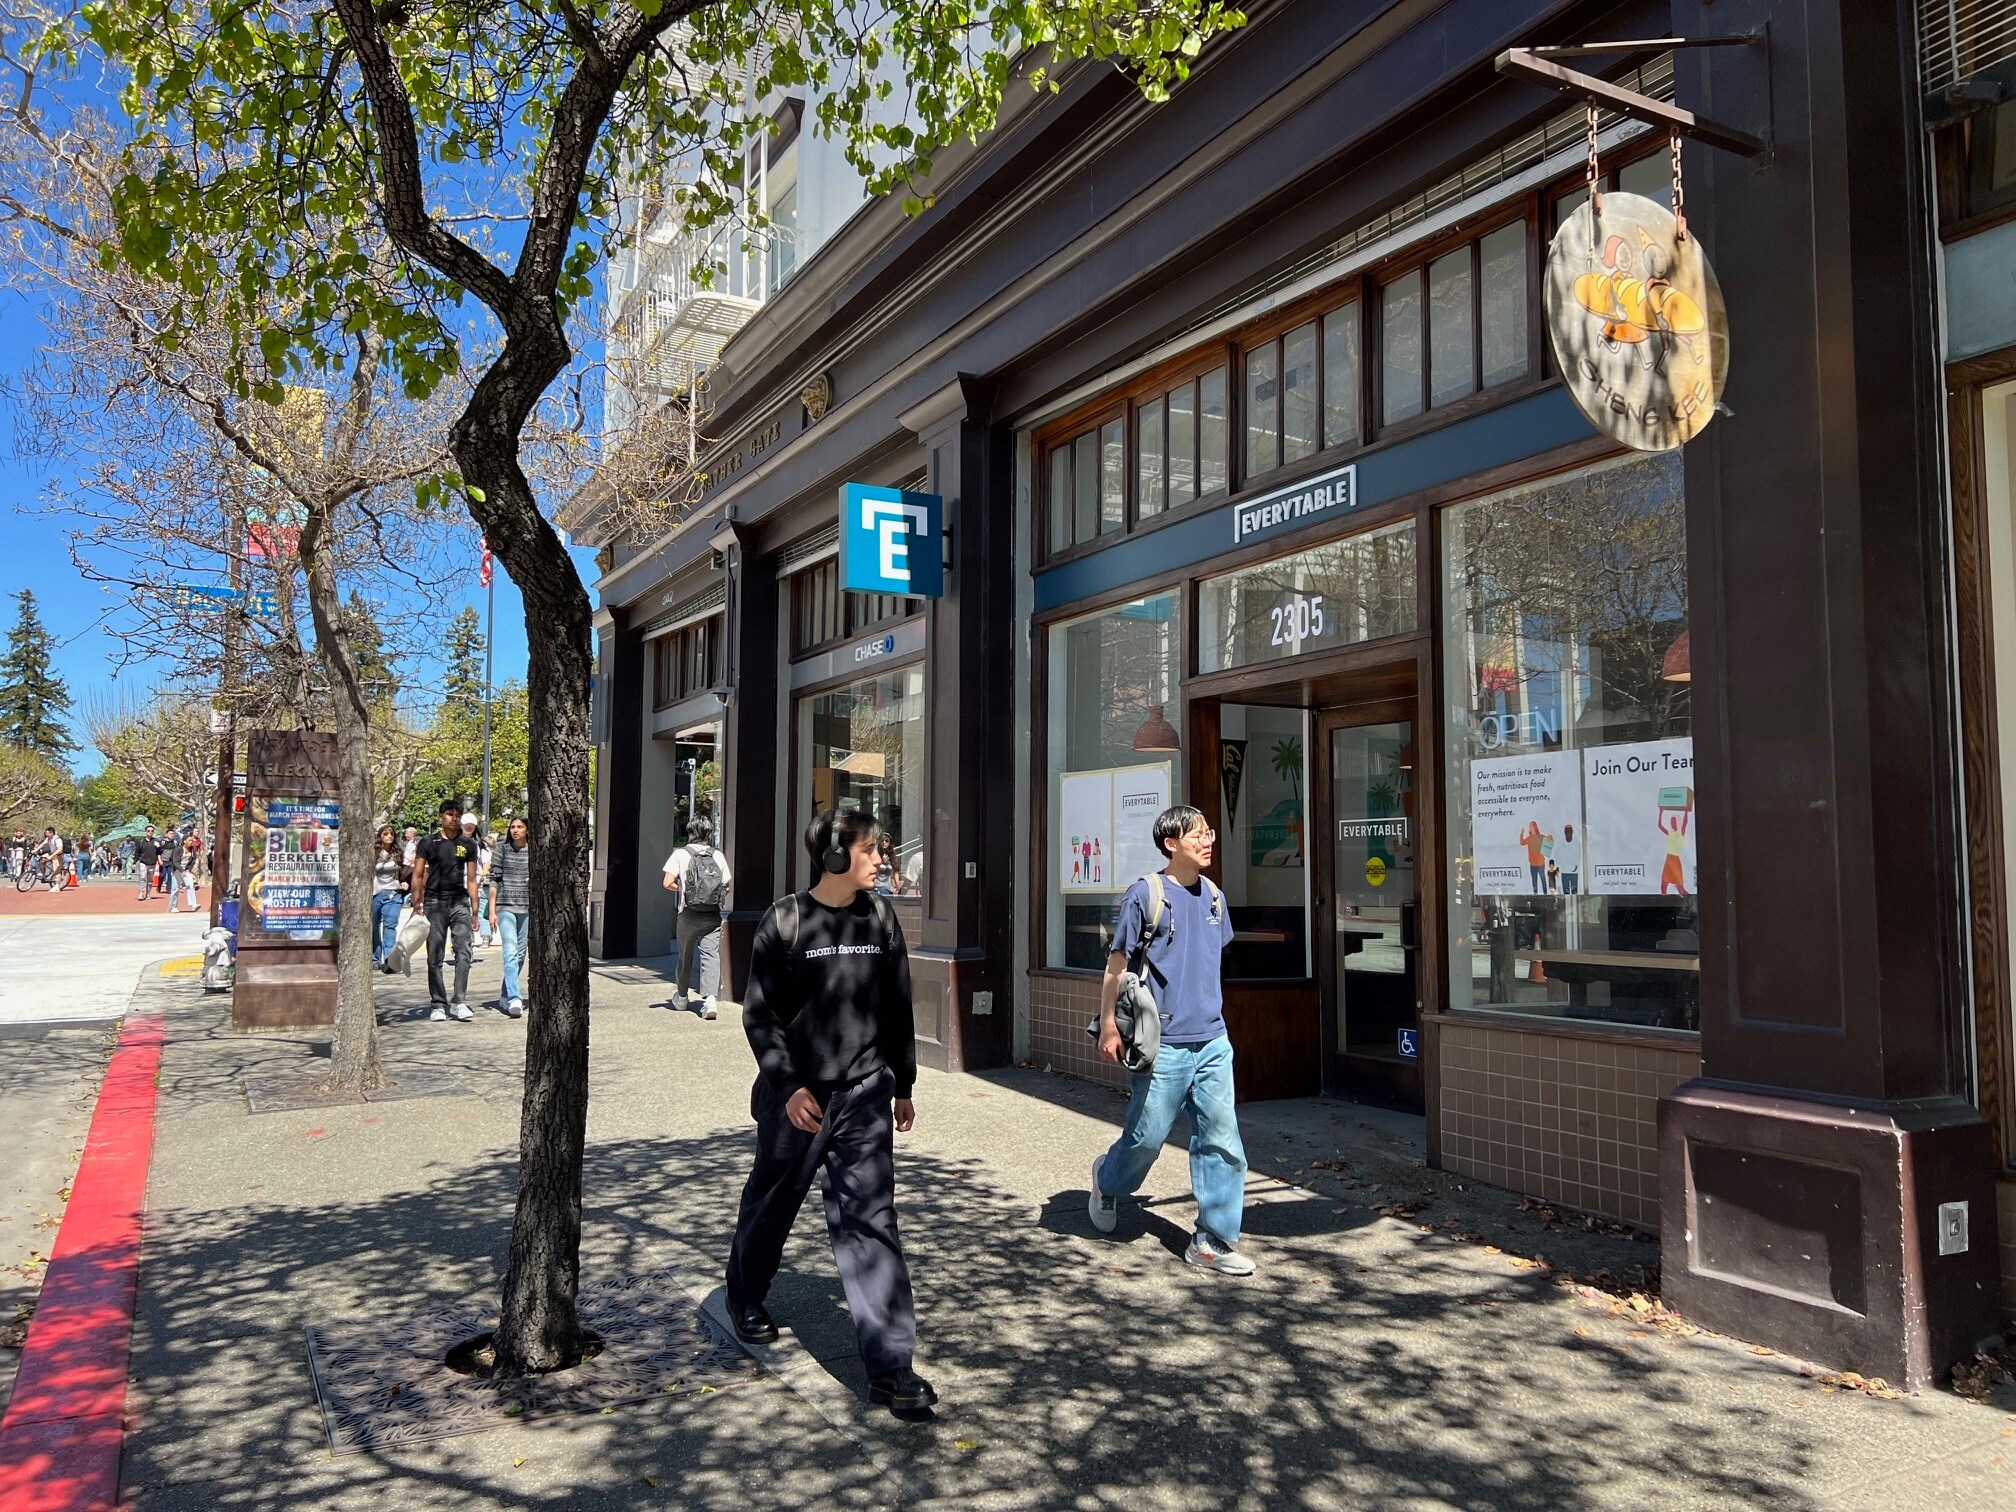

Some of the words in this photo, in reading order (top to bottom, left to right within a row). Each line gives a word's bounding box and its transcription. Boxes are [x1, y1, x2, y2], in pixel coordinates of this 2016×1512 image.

[1580, 358, 1660, 427] SHENG
[1669, 381, 1709, 425] KEE
[750, 422, 780, 458] GATE
[1241, 480, 1347, 535] EVERYTABLE
[1271, 596, 1323, 646] 2305
[855, 638, 884, 662] CHASE
[1480, 710, 1559, 750] OPEN
[250, 763, 340, 778] TELEGRA
[1476, 770, 1490, 780] Our
[1492, 769, 1516, 779] mission
[1517, 769, 1523, 777] is
[1524, 768, 1531, 776] to
[1533, 766, 1552, 775] make
[1592, 759, 1621, 776] Join
[1626, 756, 1657, 773] Our
[1477, 783, 1495, 795] fresh,
[1497, 780, 1528, 792] nutritious
[1529, 778, 1546, 792] food
[1125, 797, 1157, 807] EVERYTABLE
[1477, 795, 1508, 805] accessible
[1510, 795, 1517, 803] to
[1518, 793, 1550, 805] everyone,
[1477, 808, 1515, 820] everywhere.
[1343, 824, 1403, 838] EVERYTABLE
[269, 831, 318, 853] BRW
[269, 853, 337, 862] BERKELEY
[268, 863, 314, 871] RESTAURANT
[316, 863, 336, 872] WEEK
[1481, 869, 1519, 878] EVERYTABLE
[1598, 867, 1641, 876] EVERYTABLE
[268, 875, 291, 883] MARCH
[268, 889, 290, 898] VIEW
[292, 889, 311, 898] OUR
[267, 898, 301, 908] ROSTER
[805, 945, 836, 958] mom's
[838, 944, 882, 955] favorite.
